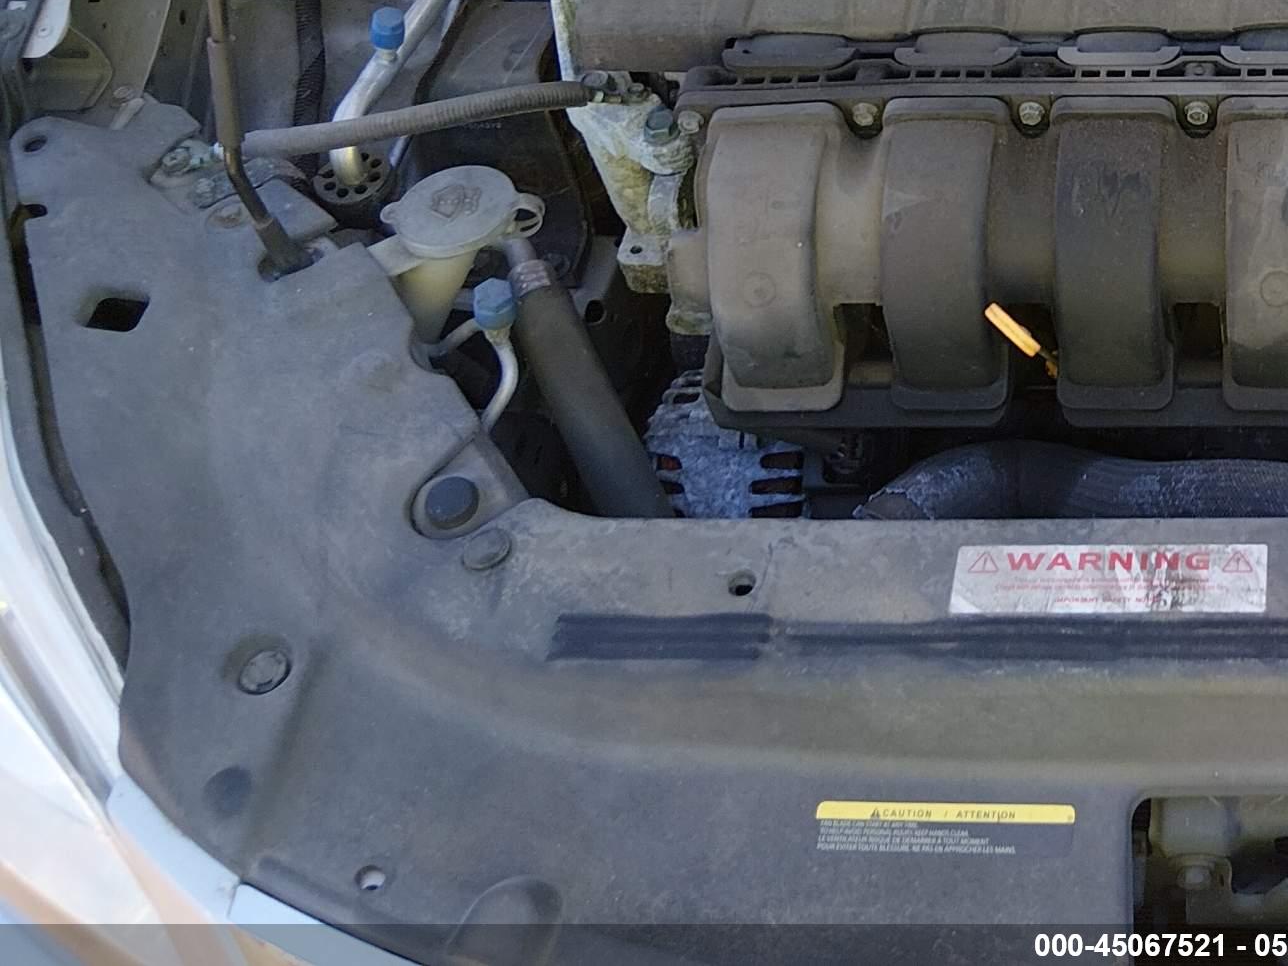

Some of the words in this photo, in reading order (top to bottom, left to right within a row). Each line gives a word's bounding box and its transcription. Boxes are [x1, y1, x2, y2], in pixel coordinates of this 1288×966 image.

[1007, 552, 1210, 571] WARNING
[883, 809, 932, 819] CAUTION
[956, 810, 1016, 819] ATTENTION
